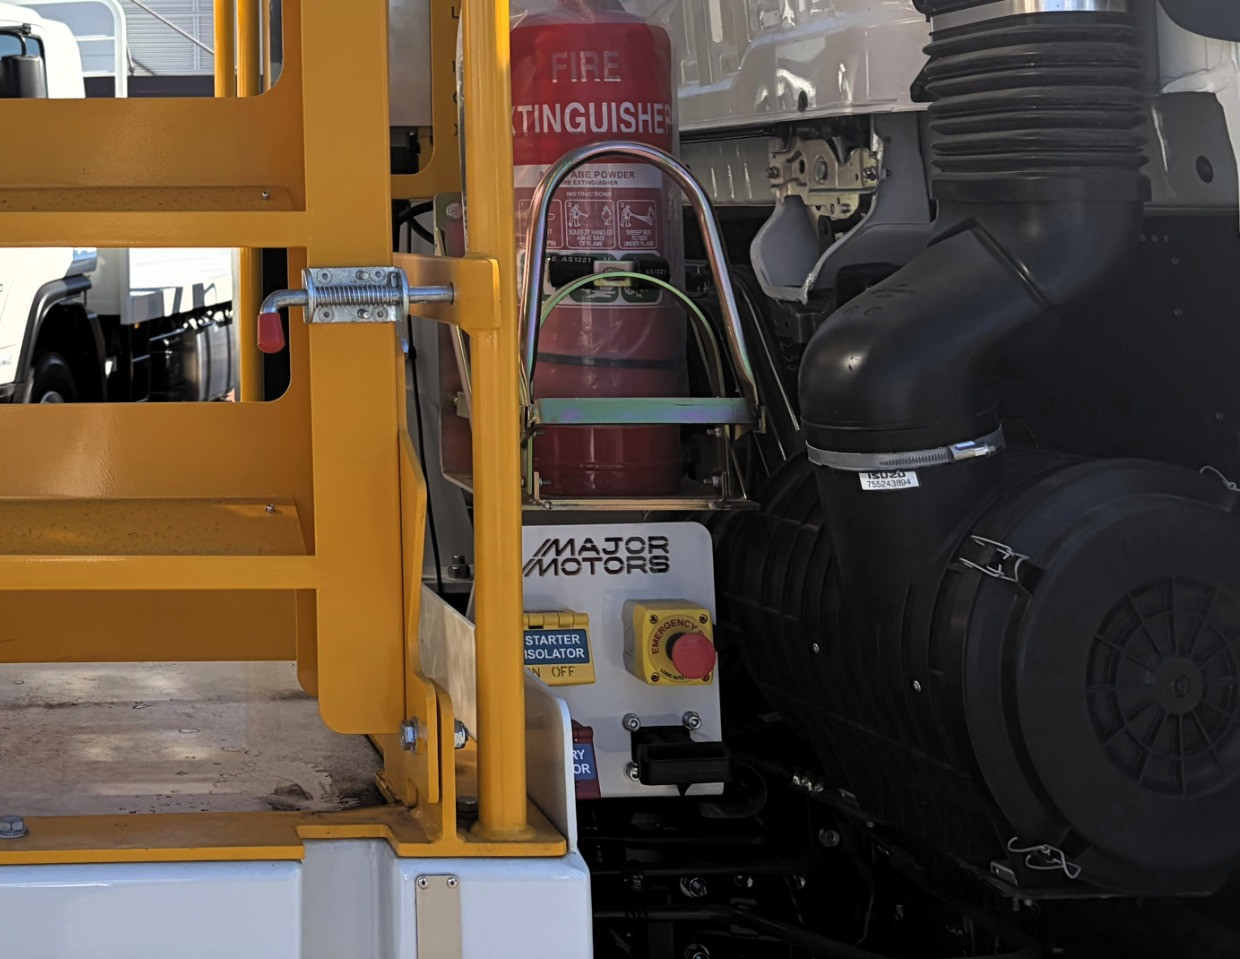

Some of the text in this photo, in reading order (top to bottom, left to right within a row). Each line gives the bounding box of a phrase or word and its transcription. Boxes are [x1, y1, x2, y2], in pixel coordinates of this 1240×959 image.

[552, 50, 621, 83] FIRE
[571, 171, 635, 179] ABE POWDER
[533, 536, 670, 558] MAJOR
[523, 555, 670, 577] MOTORS
[525, 634, 580, 646] STARTER
[652, 619, 698, 654] EMERGENCY
[524, 648, 585, 659] ISOLATOR
[551, 666, 575, 677] OFF
